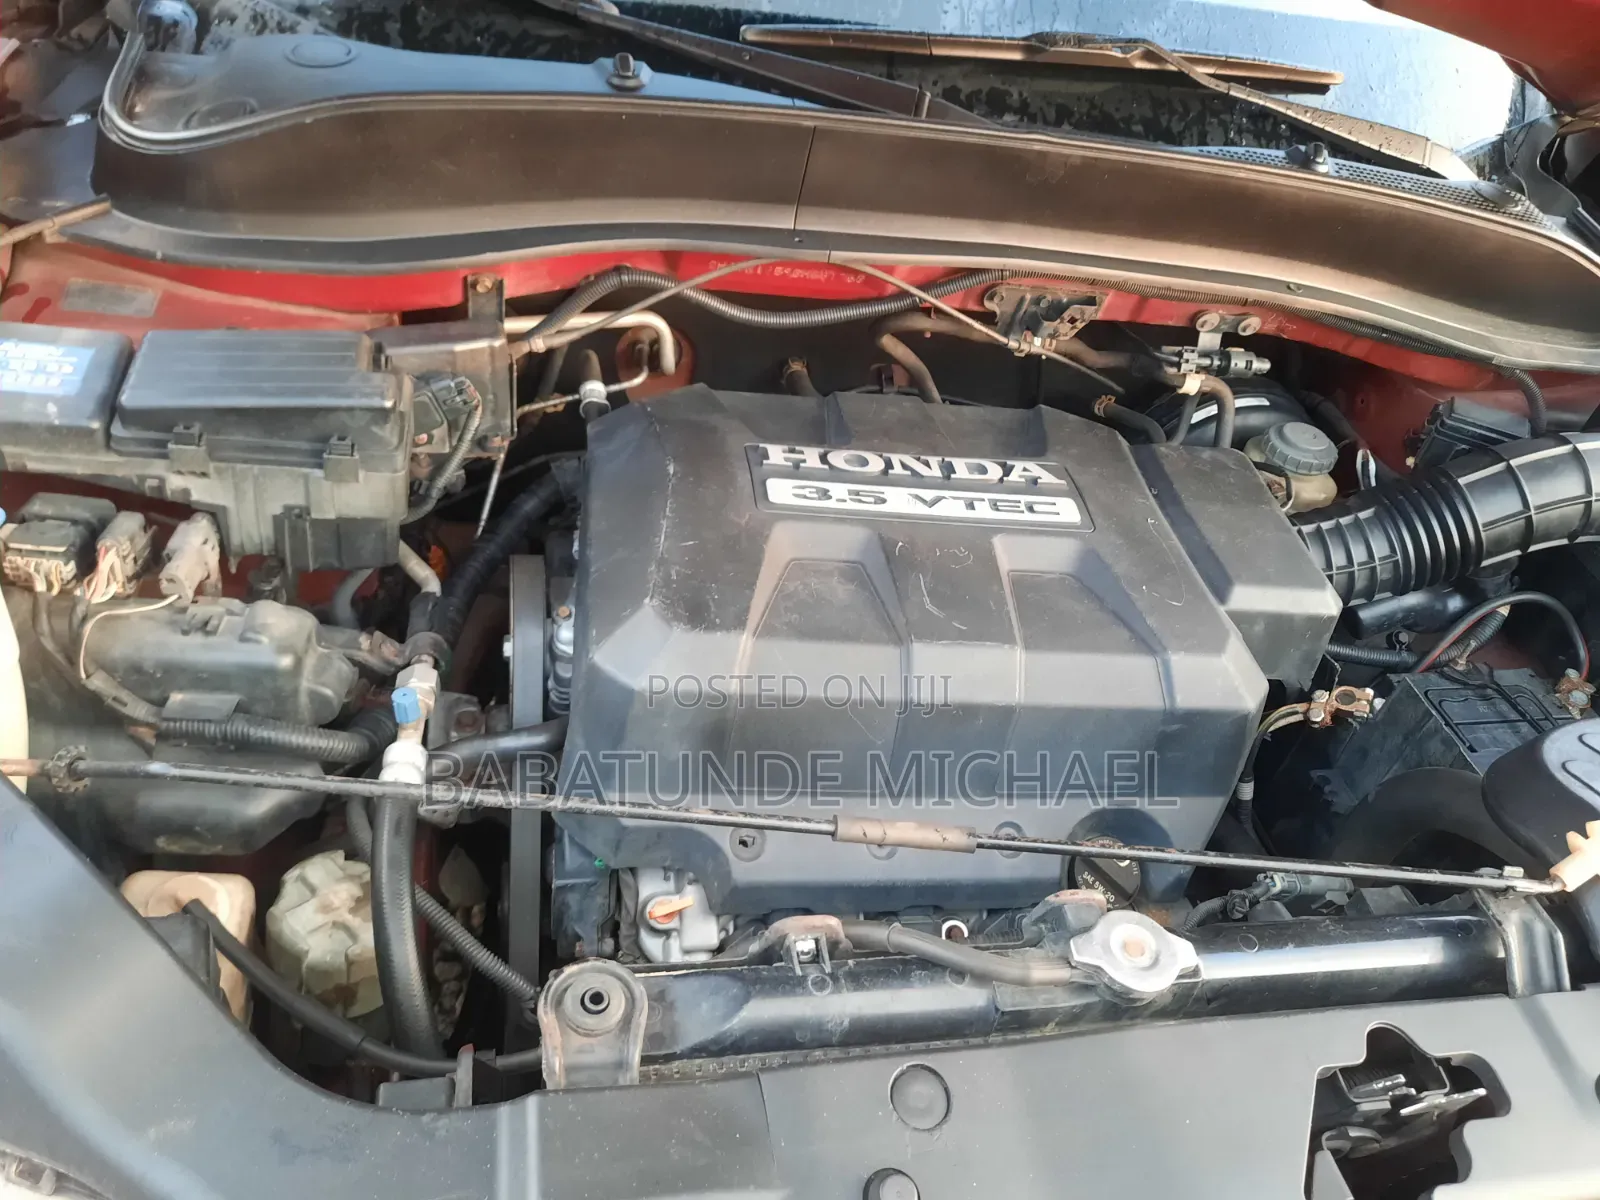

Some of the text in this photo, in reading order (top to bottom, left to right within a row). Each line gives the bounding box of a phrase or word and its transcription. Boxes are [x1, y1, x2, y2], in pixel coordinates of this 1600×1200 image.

[758, 443, 1068, 488] HONDA
[791, 484, 1061, 516] 3.5 VTEC
[1082, 871, 1095, 885] SAE
